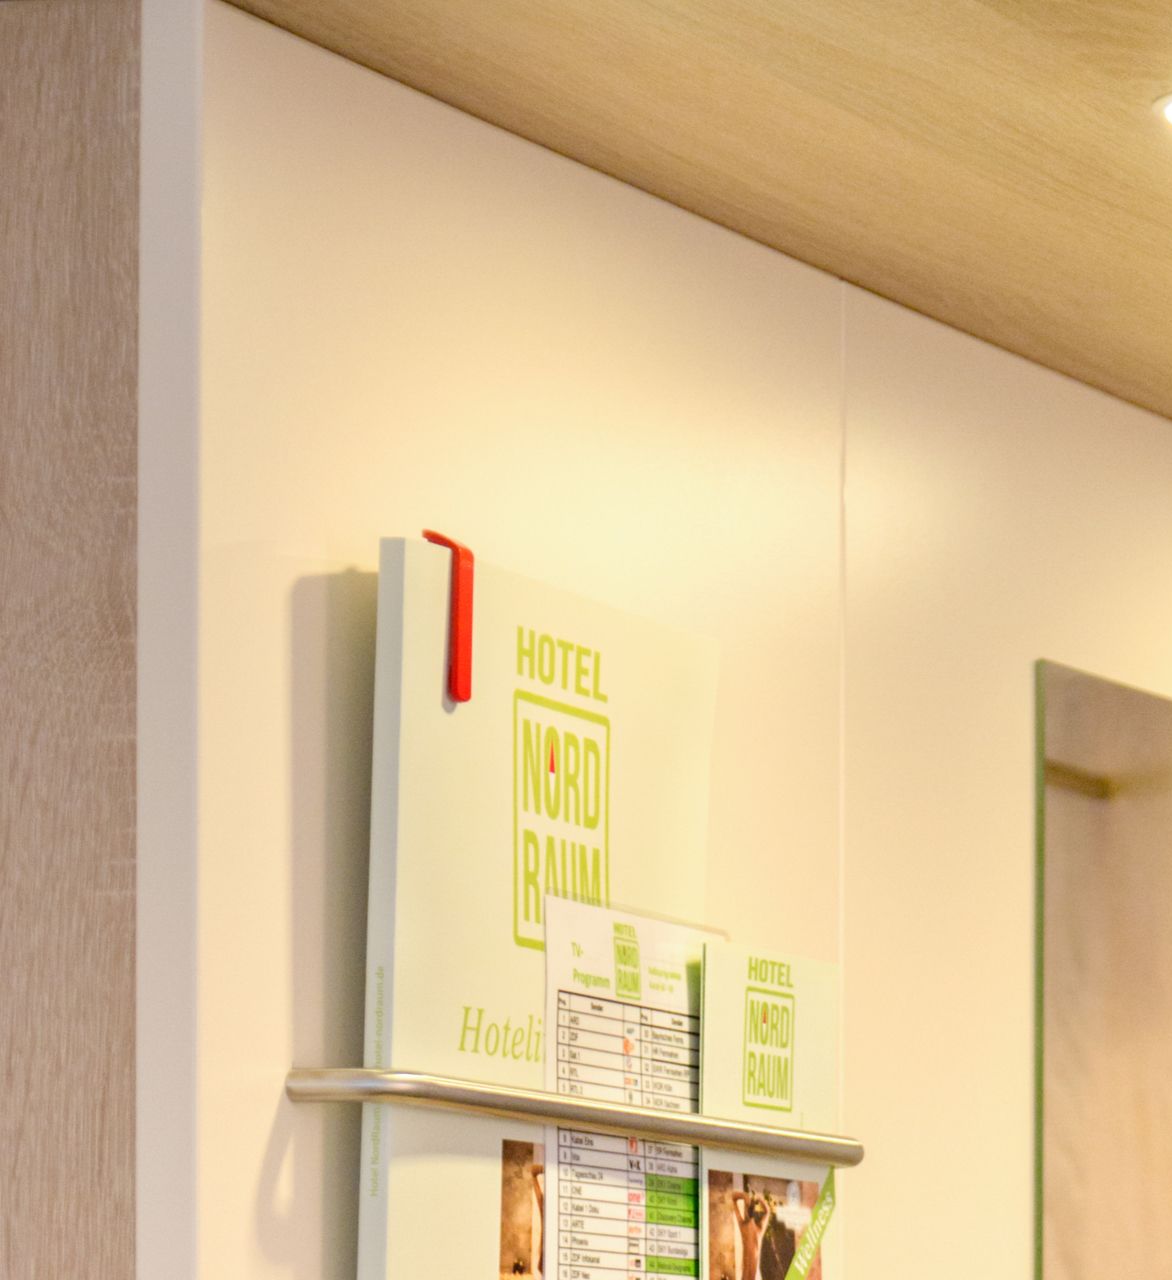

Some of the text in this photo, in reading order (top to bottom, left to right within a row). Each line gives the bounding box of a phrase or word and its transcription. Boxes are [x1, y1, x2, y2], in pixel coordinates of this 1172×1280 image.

[517, 626, 608, 703] HOTEL
[523, 718, 600, 830] NORD
[573, 968, 610, 988] Programm
[748, 956, 793, 988] HOTEL
[458, 1006, 545, 1063] Hoteli
[749, 999, 789, 1048] NORD
[748, 1051, 788, 1100] RAUM
[794, 1191, 834, 1276] Wellness
